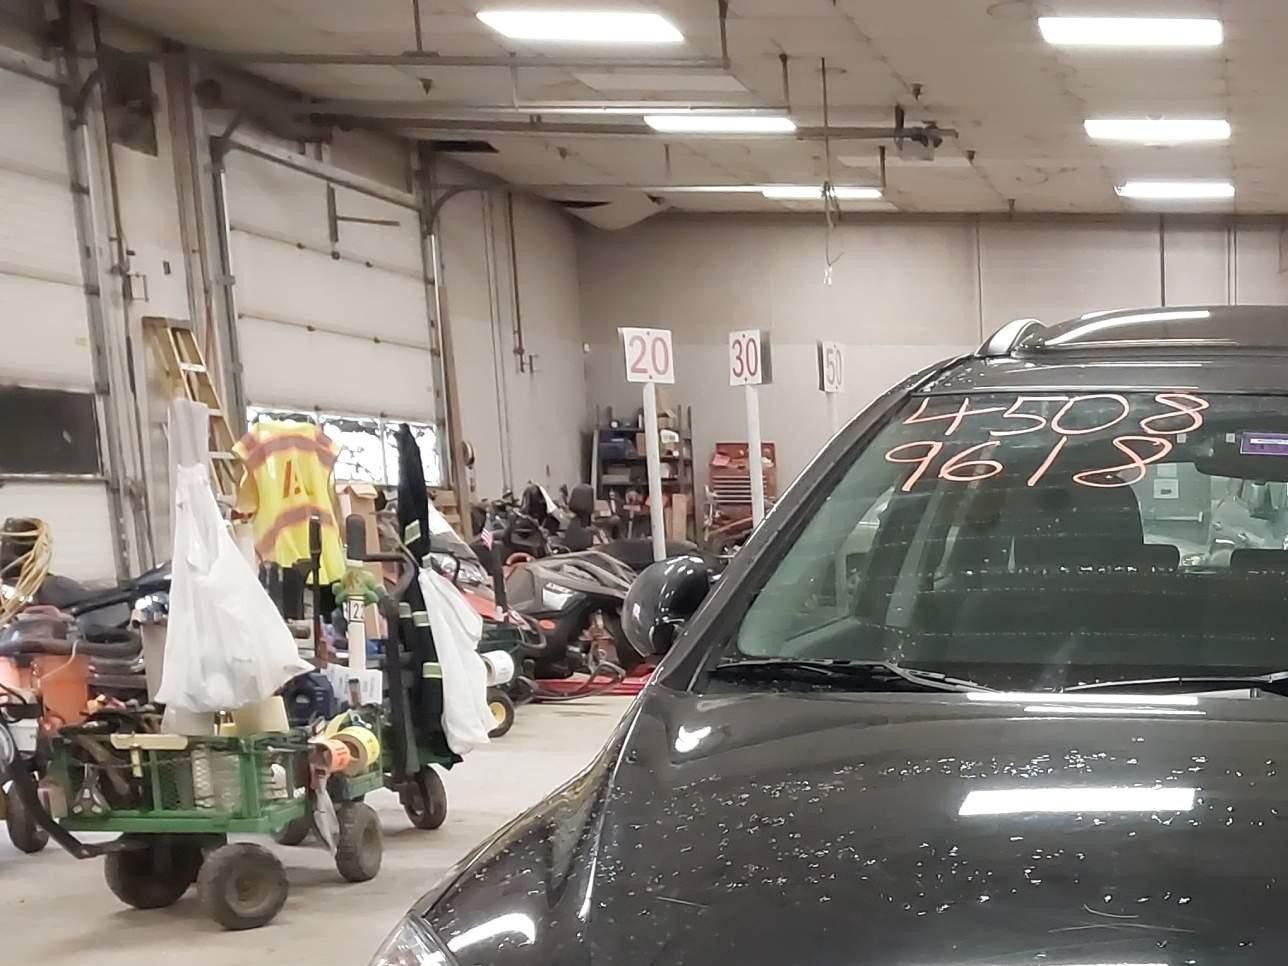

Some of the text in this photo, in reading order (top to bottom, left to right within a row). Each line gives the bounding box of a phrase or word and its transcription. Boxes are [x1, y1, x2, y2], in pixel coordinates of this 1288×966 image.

[628, 335, 669, 376] 20
[732, 337, 758, 378] 30
[902, 393, 1209, 436] 4508
[885, 434, 1173, 492] 9618
